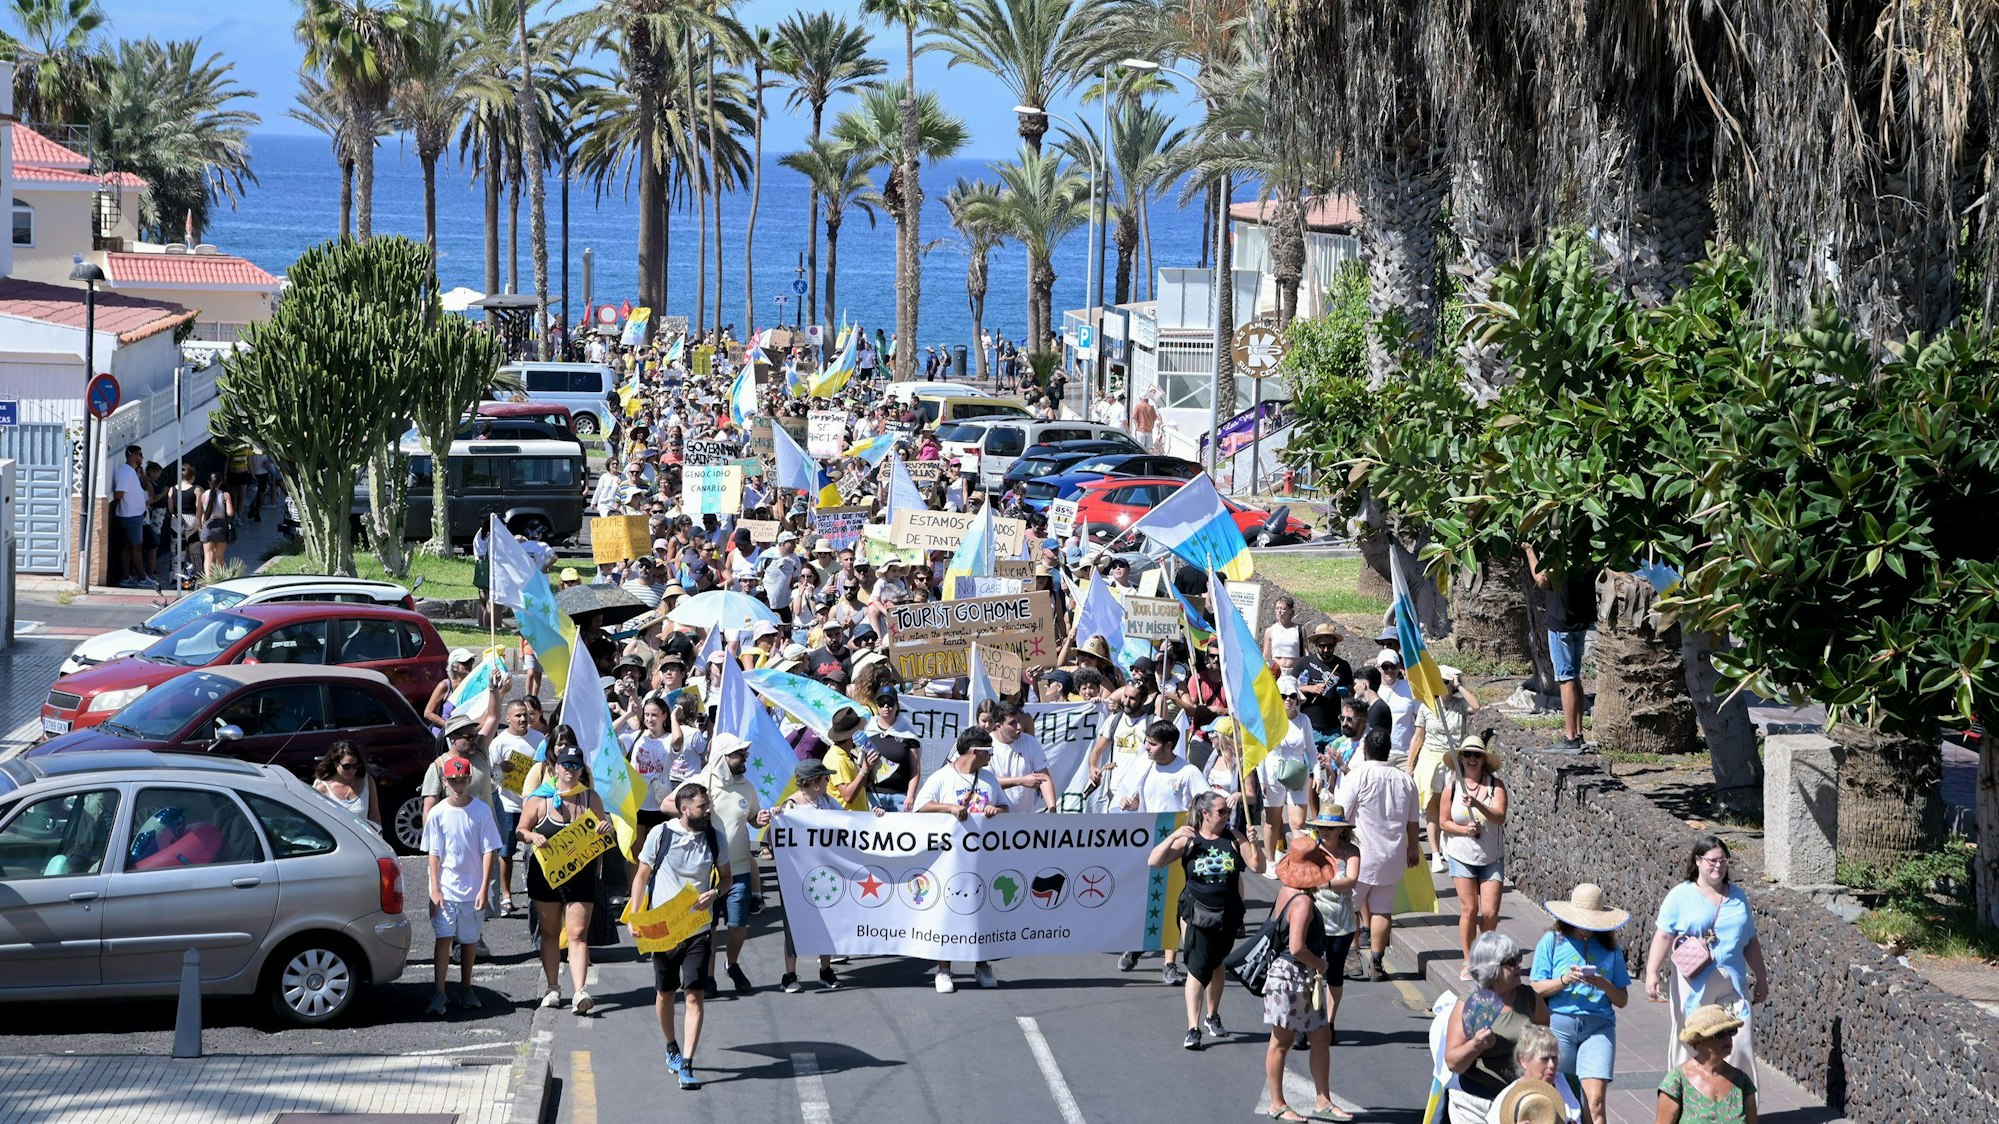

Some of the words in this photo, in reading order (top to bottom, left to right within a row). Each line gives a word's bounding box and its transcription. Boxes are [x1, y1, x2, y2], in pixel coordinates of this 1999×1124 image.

[1080, 329, 1088, 345] P
[1234, 330, 1246, 347] LAS
[1237, 361, 1256, 375] SURF
[685, 469, 730, 478] GENOCIDIO
[691, 483, 727, 492] CANARIO
[592, 519, 606, 529] NO
[609, 517, 623, 527] ME
[909, 514, 965, 530] ESTAMOS
[905, 534, 921, 544] DE
[925, 535, 962, 546] TANTA
[957, 583, 974, 594] NO
[955, 603, 980, 621] GO
[983, 599, 1031, 622] HOME
[931, 630, 941, 638] the
[1127, 619, 1144, 634] MY
[1065, 711, 1099, 742] ES
[774, 828, 797, 848] EL
[807, 829, 916, 852] TURISMO
[927, 831, 953, 852] ES
[962, 828, 1149, 852] COLONIALISMO
[857, 924, 906, 941] Bloque
[911, 926, 1016, 947] Independentista
[1020, 925, 1071, 941] Canario
